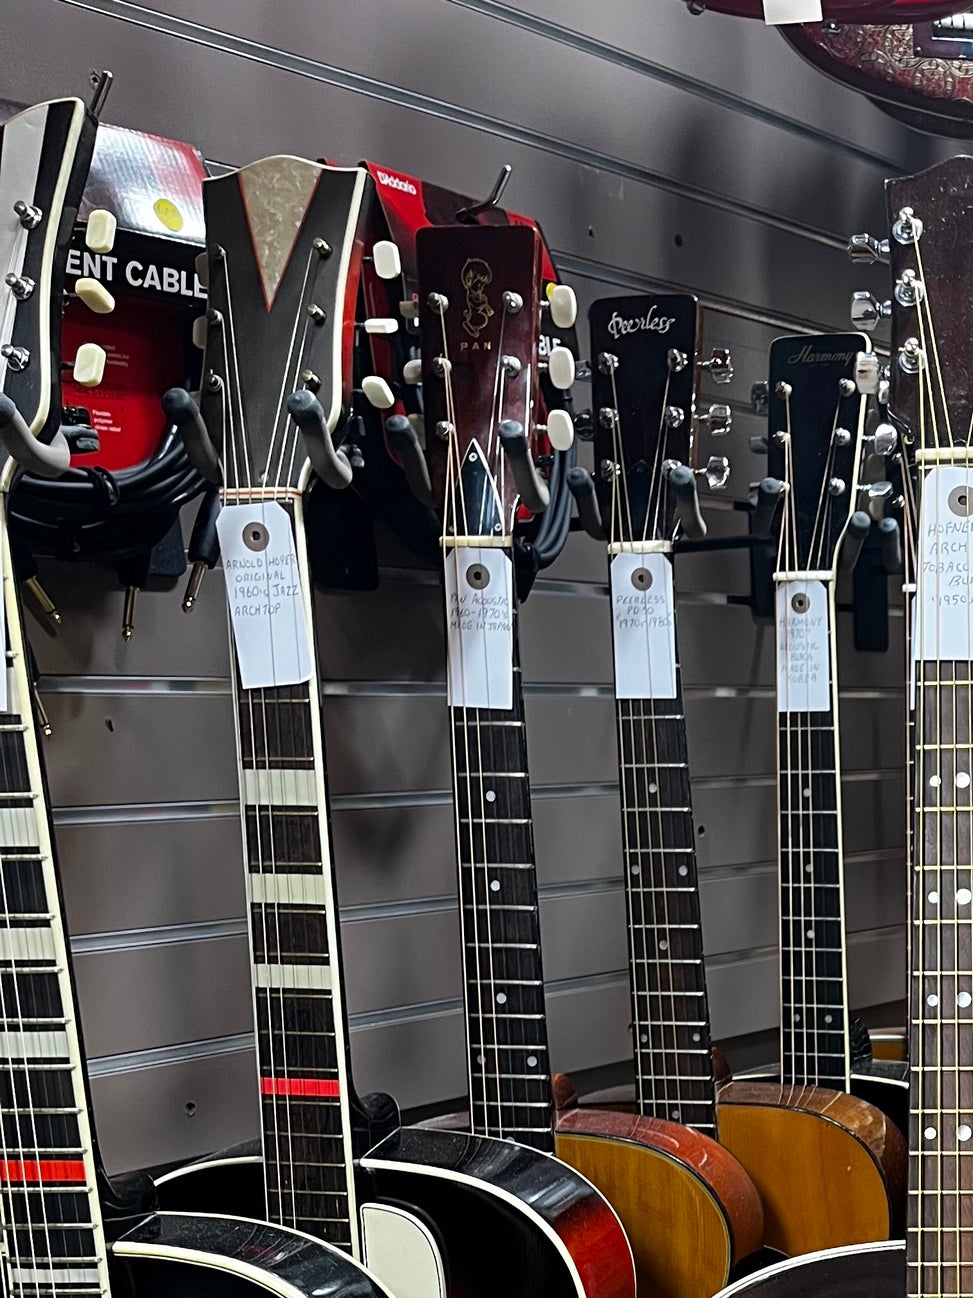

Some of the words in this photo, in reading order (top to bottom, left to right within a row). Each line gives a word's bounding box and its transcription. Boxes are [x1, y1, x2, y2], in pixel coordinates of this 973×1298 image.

[125, 260, 208, 299] CABLE
[608, 305, 677, 339] Peerless
[460, 341, 492, 351] PAN
[786, 344, 856, 368] Harmony
[226, 558, 263, 570] ARNOLD
